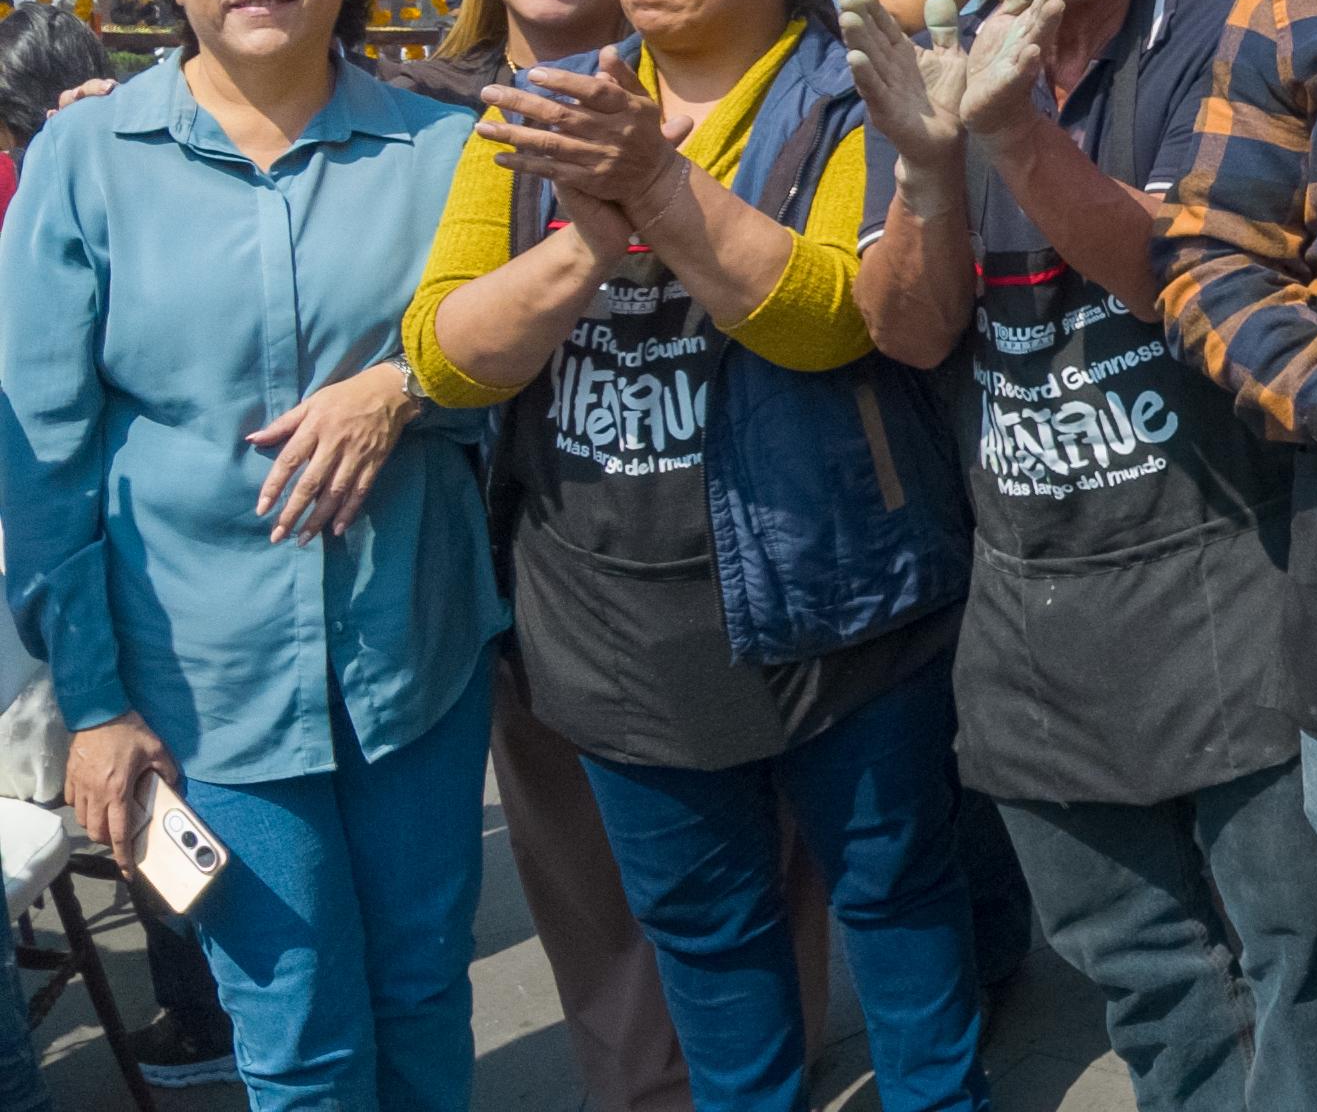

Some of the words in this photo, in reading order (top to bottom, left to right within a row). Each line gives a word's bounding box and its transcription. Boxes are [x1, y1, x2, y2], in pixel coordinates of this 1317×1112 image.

[991, 321, 1057, 341] TOLUCA
[992, 372, 1063, 403] Record
[1061, 340, 1166, 391] Guinness
[556, 432, 590, 458] Más
[624, 455, 654, 477] del
[997, 476, 1031, 497] Más
[1032, 479, 1074, 500] largo
[1076, 472, 1104, 491] del
[1106, 454, 1167, 487] mundo
